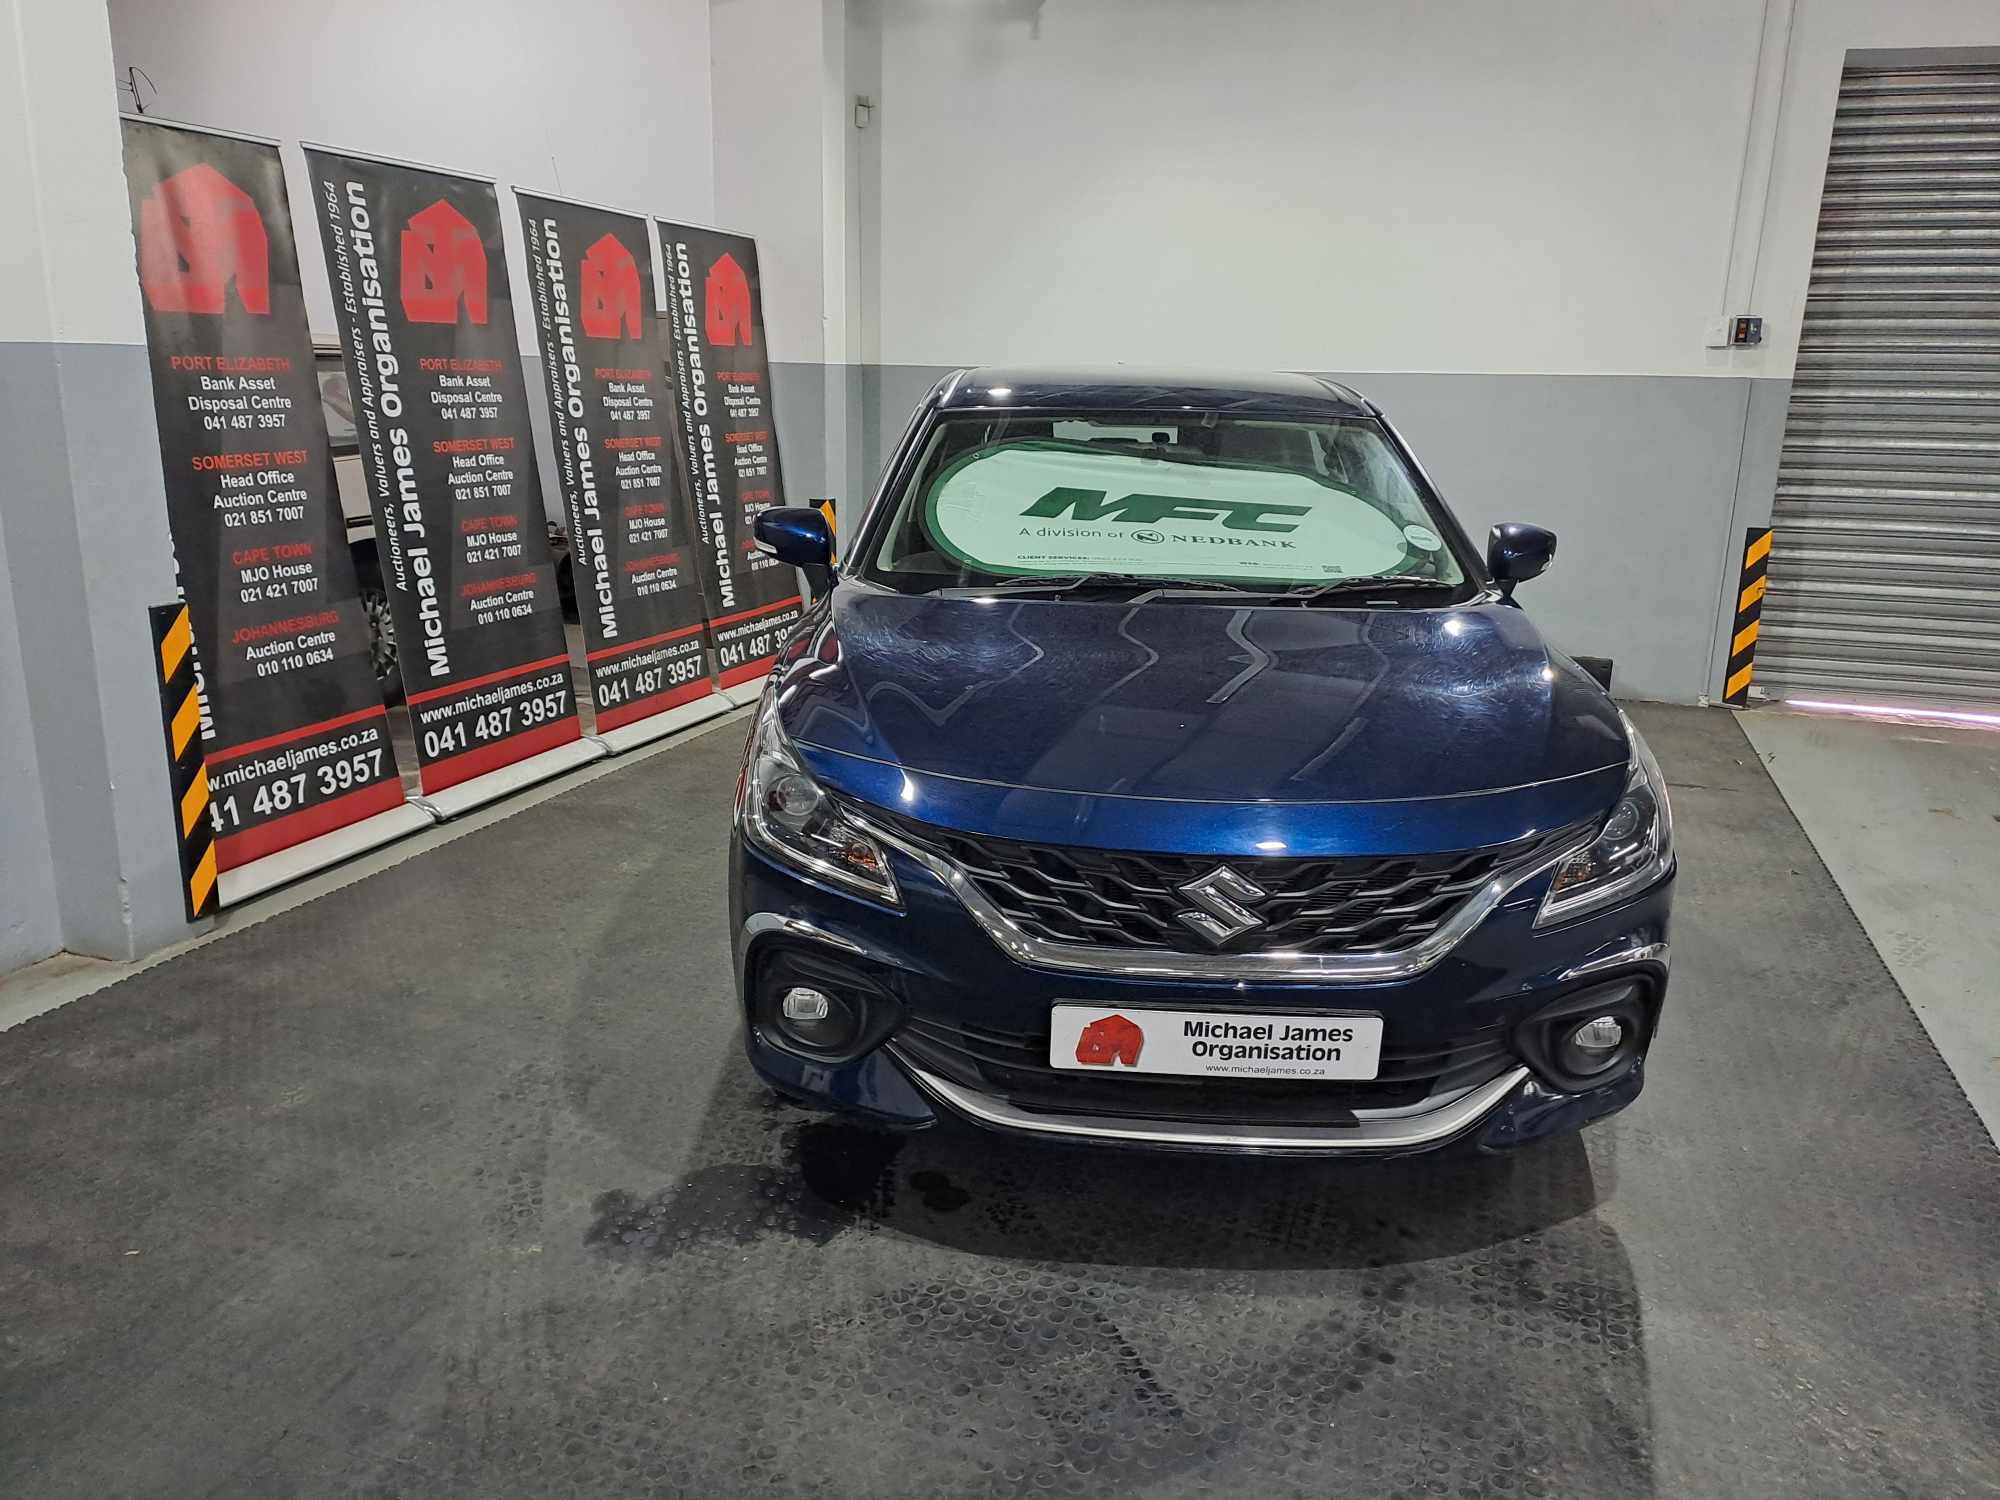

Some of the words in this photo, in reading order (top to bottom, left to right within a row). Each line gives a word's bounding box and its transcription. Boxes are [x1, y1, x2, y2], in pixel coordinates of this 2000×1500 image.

[323, 180, 341, 225] 1964
[528, 219, 540, 253] 1964
[334, 225, 357, 313] Established
[665, 243, 674, 273] 1964
[346, 181, 402, 418] Organisation
[531, 254, 552, 330] Established
[543, 219, 583, 418] Organisation
[667, 275, 681, 341] Established
[676, 242, 707, 416] Organisation
[171, 356, 212, 371] PORT
[216, 357, 290, 371] ELIZABETH
[351, 326, 374, 407] Appraisers
[547, 341, 563, 409] Appraisers
[201, 376, 235, 390] Bank
[239, 376, 276, 389] Asset
[439, 375, 464, 386] Bank
[466, 375, 491, 386] Asset
[608, 382, 625, 393] Bank
[677, 350, 690, 409] Appraisers
[188, 396, 247, 413] Disposal
[251, 396, 292, 409] Centre
[431, 391, 472, 405] Disposal
[474, 391, 503, 403] Centre
[603, 396, 631, 408] Disposal
[204, 416, 226, 430] 041
[231, 415, 253, 428] 487
[258, 414, 286, 428] 3957
[363, 409, 380, 440] and
[441, 408, 458, 419] 041
[460, 408, 476, 419] 487
[480, 407, 498, 418] 3957
[556, 411, 568, 437] and
[682, 411, 693, 432] and
[192, 451, 270, 470] SOMERSET
[273, 450, 308, 464] WEST
[371, 441, 390, 497] Valuers
[452, 456, 476, 468] Head
[478, 454, 504, 466] Office
[561, 440, 575, 485] Valuers
[616, 466, 640, 476] Auction
[641, 464, 662, 474] Centre
[618, 451, 635, 462] Head
[636, 450, 656, 461] Office
[688, 436, 700, 475] Valuers
[699, 424, 720, 504] James
[220, 473, 254, 488] Head
[258, 470, 295, 484] Office
[389, 428, 425, 538] James
[447, 471, 484, 485] Auction
[485, 470, 514, 481] Centre
[574, 427, 600, 520] James
[620, 479, 632, 490] 021
[633, 478, 644, 489] 851
[213, 492, 264, 509] Auction
[267, 489, 308, 503] Centre
[455, 489, 471, 500] 021
[473, 487, 490, 498] 851
[492, 484, 511, 496] 7007
[224, 512, 247, 527] 021
[250, 510, 272, 524] 851
[276, 506, 304, 521] 7007
[644, 517, 665, 527] House
[694, 479, 710, 544] Auctioneers,
[1019, 486, 1312, 533] MFC
[466, 533, 487, 547] MJO
[489, 531, 517, 544] House
[570, 490, 587, 566] Auctioneers,
[1019, 527, 1031, 536] A
[1036, 526, 1101, 537] division
[1171, 533, 1296, 549] NEDBANK
[233, 547, 269, 565] CAPE
[274, 544, 312, 559] TOWN
[384, 503, 408, 591] Auctioneers,
[466, 551, 482, 564] 021
[484, 548, 499, 560] 421
[501, 544, 522, 557] 7007
[709, 512, 735, 608] Michael
[240, 567, 269, 584] MJO
[272, 562, 312, 577] House
[587, 528, 618, 639] Michael
[632, 572, 656, 584] Auction
[656, 568, 678, 578] Centre
[240, 588, 262, 603] 021
[265, 583, 288, 598] 421
[291, 578, 319, 594] 7007
[470, 595, 504, 611] Auction
[505, 590, 534, 602] Centre
[407, 547, 450, 677] Michael
[478, 612, 493, 625] 010
[495, 608, 510, 622] 110
[511, 603, 533, 617] 0634
[718, 609, 799, 642] www.michaeljames.co.za
[233, 611, 340, 644] JOHANNESBURG
[246, 640, 294, 660] Auction
[298, 631, 335, 647] Centre
[596, 639, 699, 678] www.michaeljames.co.za
[720, 642, 746, 667] 041
[750, 634, 770, 658] 487
[257, 662, 278, 677] 010
[282, 655, 303, 671] 110
[307, 648, 334, 665] 0634
[598, 677, 630, 707] 041
[635, 667, 663, 695] 487
[668, 655, 702, 684] 3957
[420, 672, 564, 724] www.michaeljames.co.za
[424, 721, 467, 758] 041
[475, 706, 512, 740] 487
[520, 691, 566, 726] 3957
[207, 728, 379, 792] w.michaeljames.co.za
[209, 795, 240, 832] 41
[253, 774, 306, 815] 487
[317, 748, 383, 795] 3957
[1183, 1020, 1273, 1041] Michael
[1280, 1024, 1353, 1042] James
[1191, 1040, 1342, 1062] Organisation
[1205, 1063, 1326, 1076] www.michaeljames.co.za
